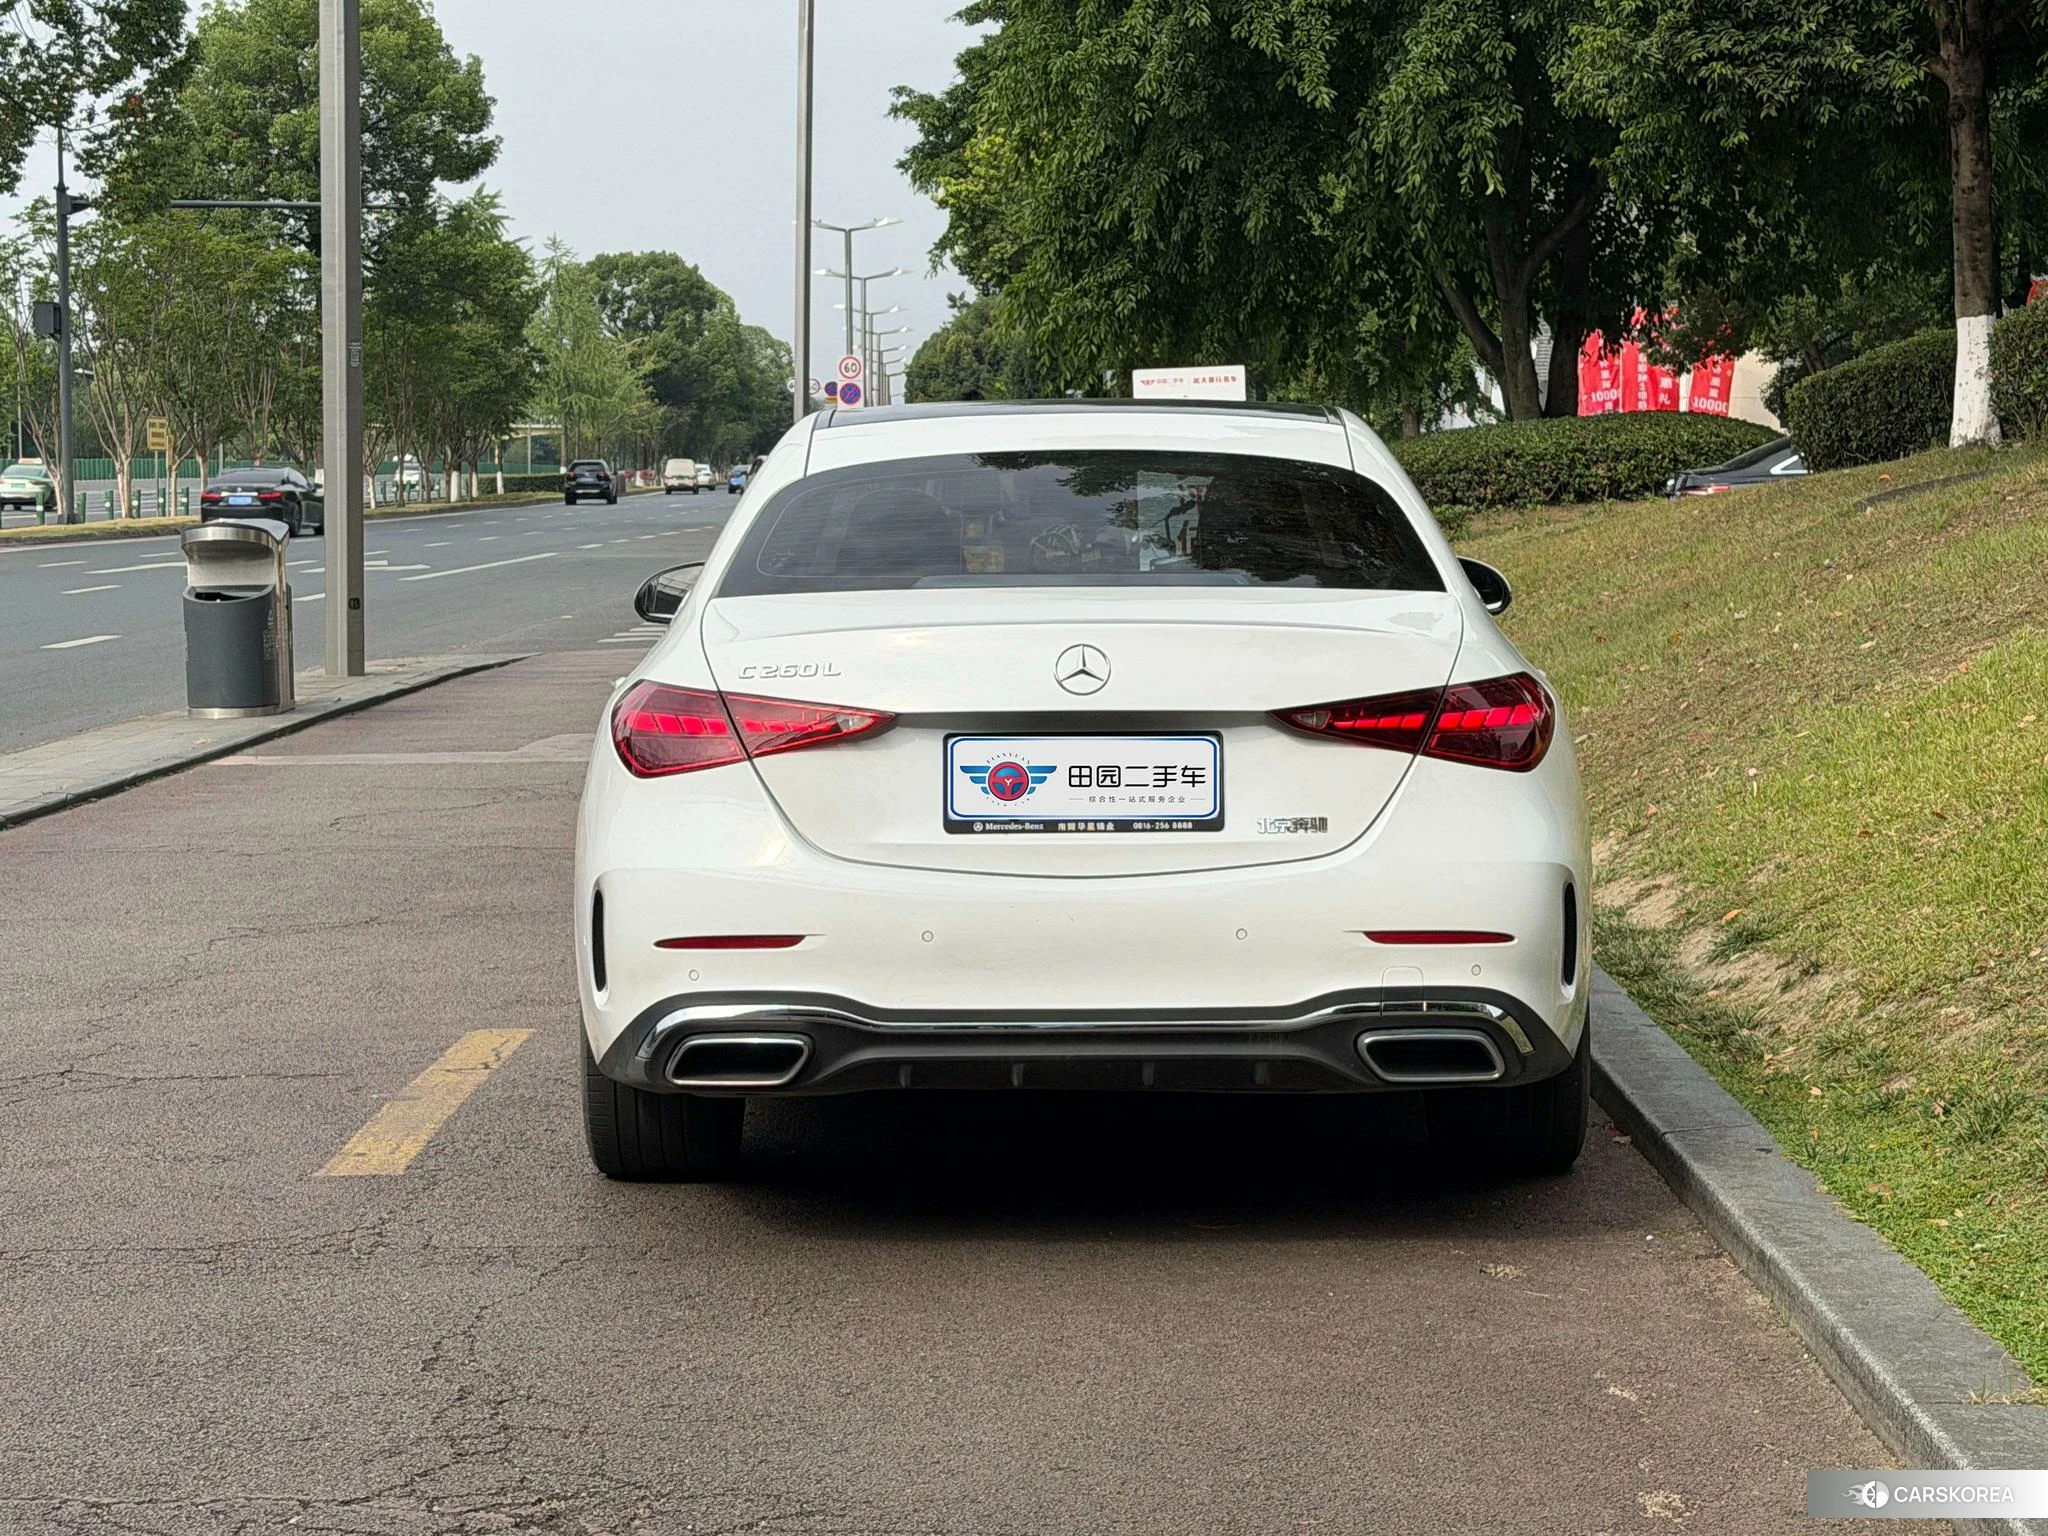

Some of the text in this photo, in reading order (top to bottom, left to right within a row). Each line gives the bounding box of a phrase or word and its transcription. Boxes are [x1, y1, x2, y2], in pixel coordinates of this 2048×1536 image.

[844, 362, 857, 373] 60
[1068, 765, 1206, 788] 田园二手车
[1088, 795, 1186, 804] 综合性一站式服务企业
[985, 821, 1044, 831] Mercedes-Benz
[1256, 816, 1328, 835] 北京奔驰
